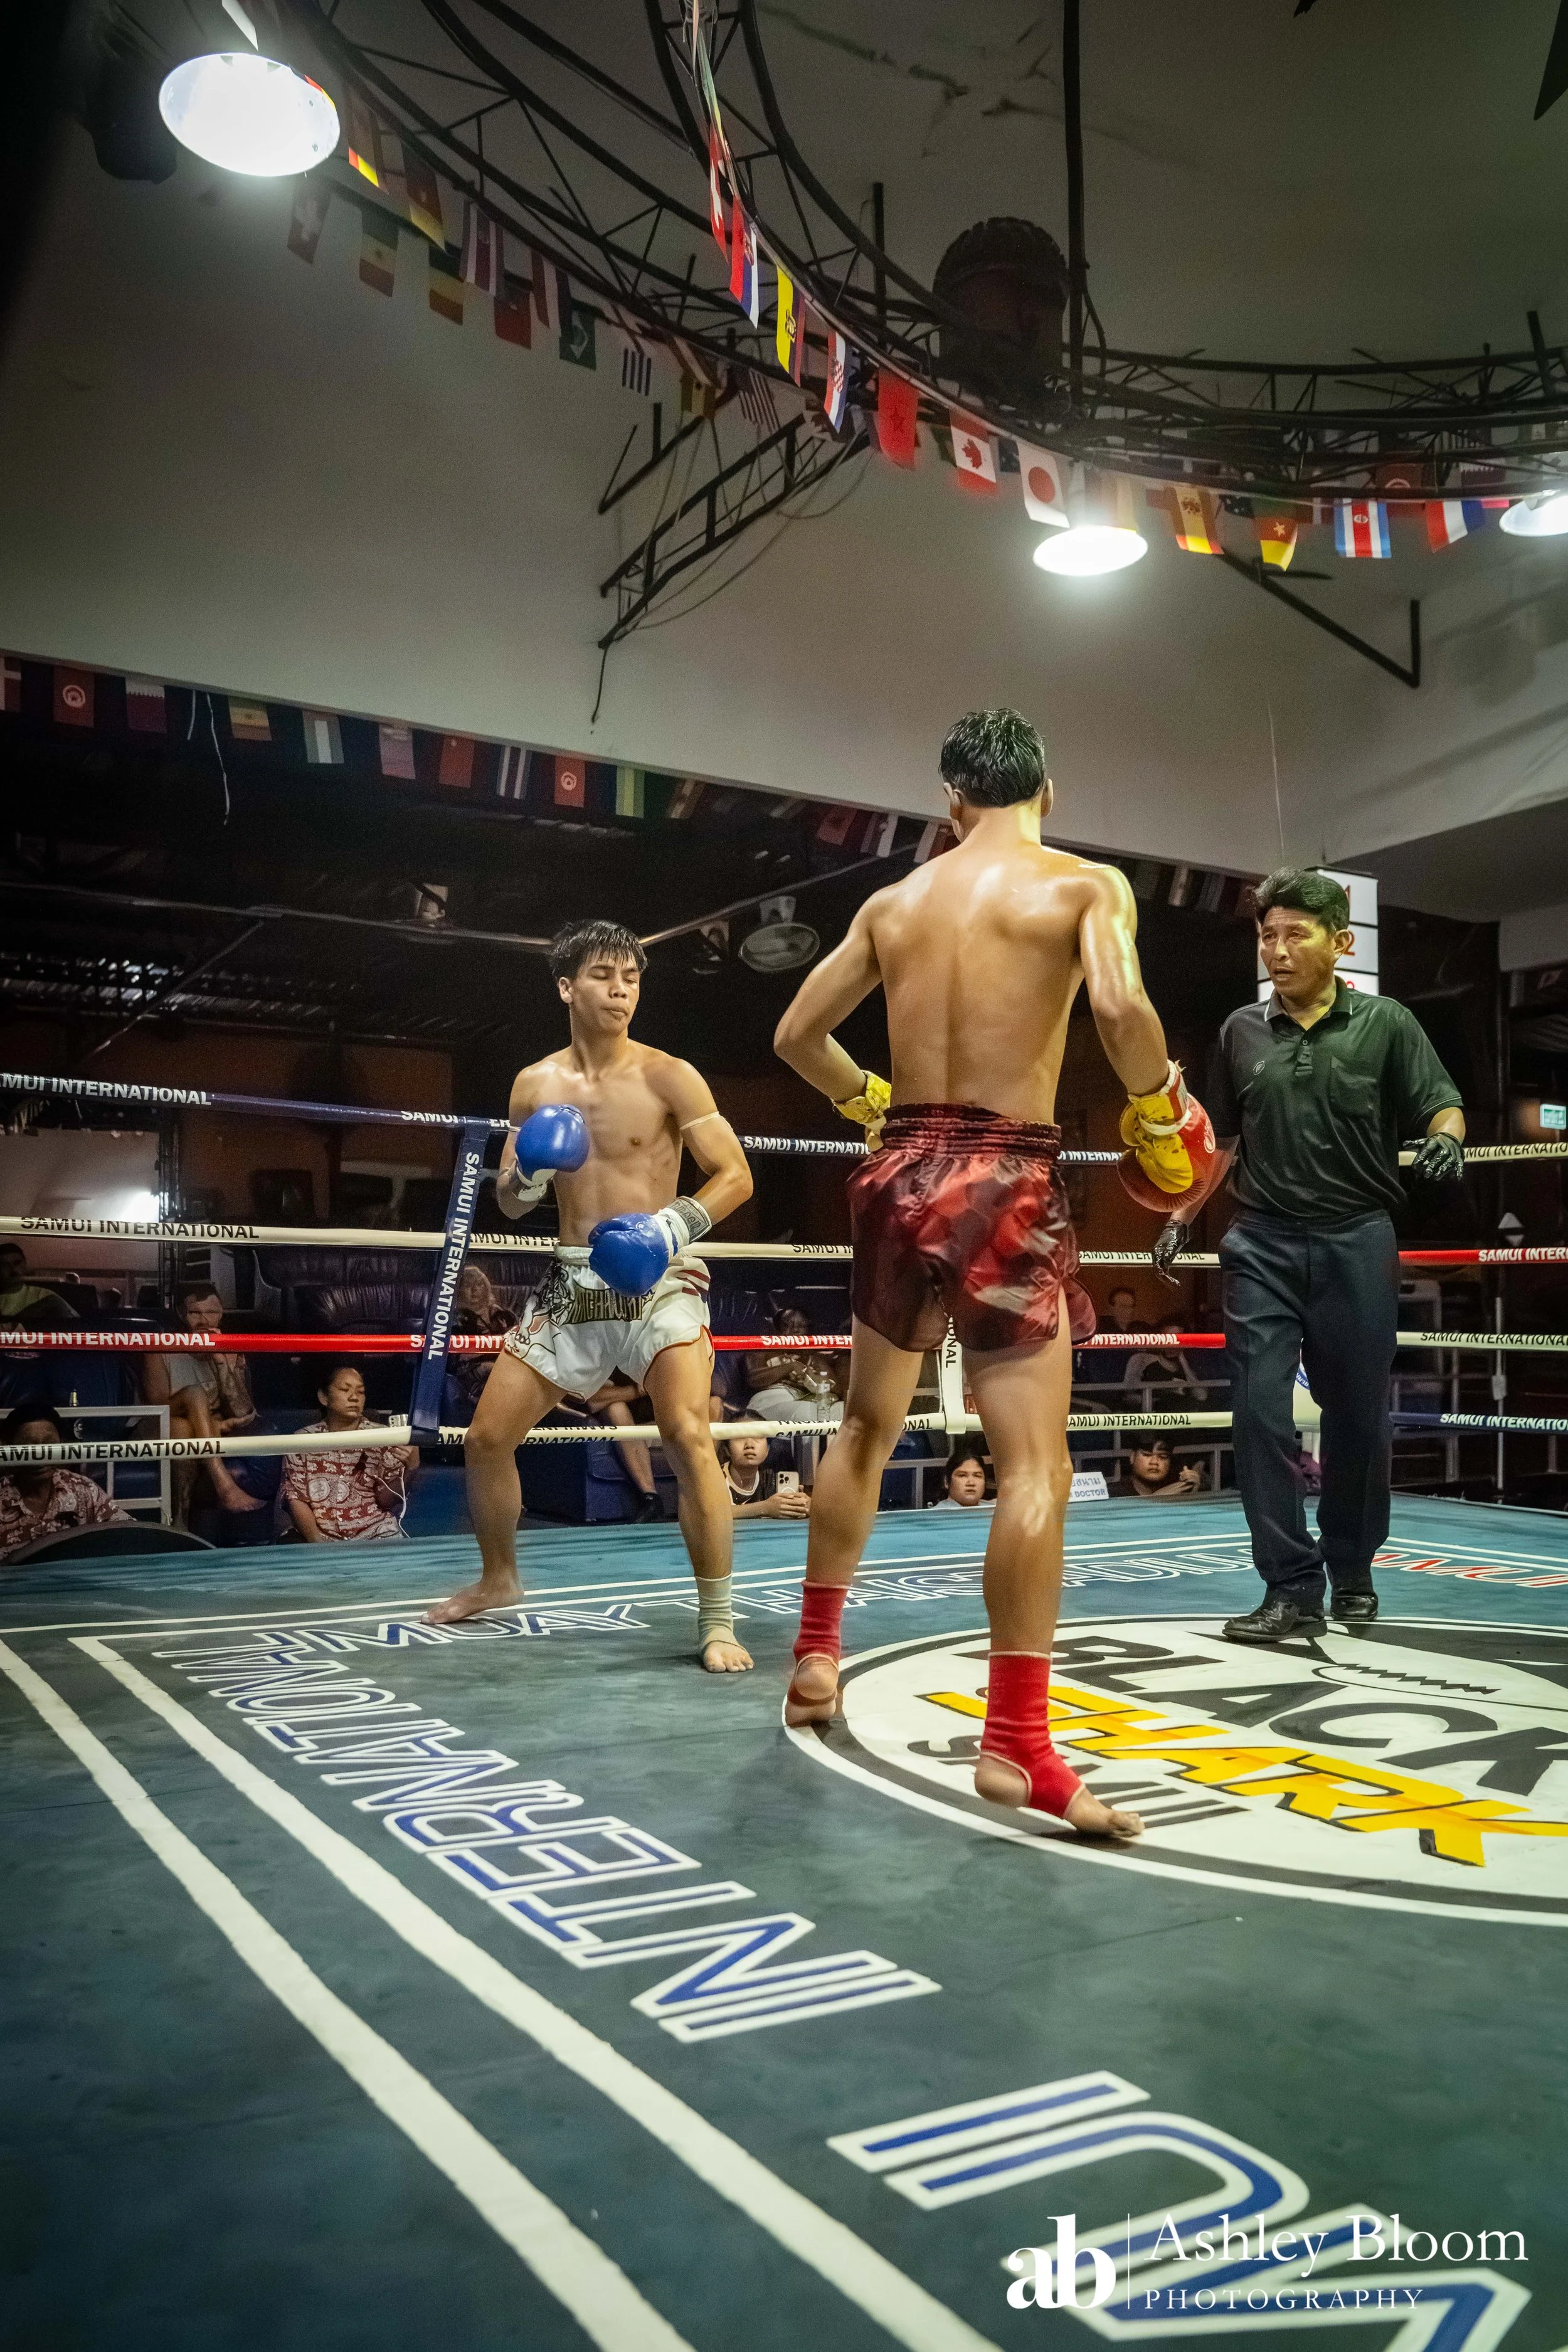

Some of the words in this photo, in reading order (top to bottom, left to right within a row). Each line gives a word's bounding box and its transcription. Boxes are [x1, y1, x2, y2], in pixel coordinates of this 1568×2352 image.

[0, 1073, 44, 1091] MUI
[51, 1078, 211, 1105] INTERNATIONAL
[744, 1136, 791, 1151] SAMUI
[456, 1152, 479, 1213] SAMUI
[21, 1217, 92, 1232] SAMUI
[100, 1220, 260, 1239] INTERNATIONAL
[1478, 1248, 1523, 1262] SAMUI
[1525, 1247, 1568, 1261] INTER
[428, 1217, 469, 1360] INTERNATIONAL
[51, 1332, 216, 1346] INTERNATIONAL
[761, 1335, 810, 1345] SAMUI
[1091, 1333, 1180, 1345] INTERNATIONAL
[1420, 1333, 1463, 1342] SAMUI
[1465, 1334, 1568, 1346] INTERNATIONA
[1103, 1414, 1192, 1427] INTERNATIONAL
[1440, 1413, 1485, 1427] SAMUI
[1486, 1415, 1568, 1431] INTERNATIO
[61, 1440, 226, 1460] INTERNATIONAL
[1074, 1488, 1106, 1498] DOCTOR
[151, 1631, 943, 2045] INTERNATIONAL
